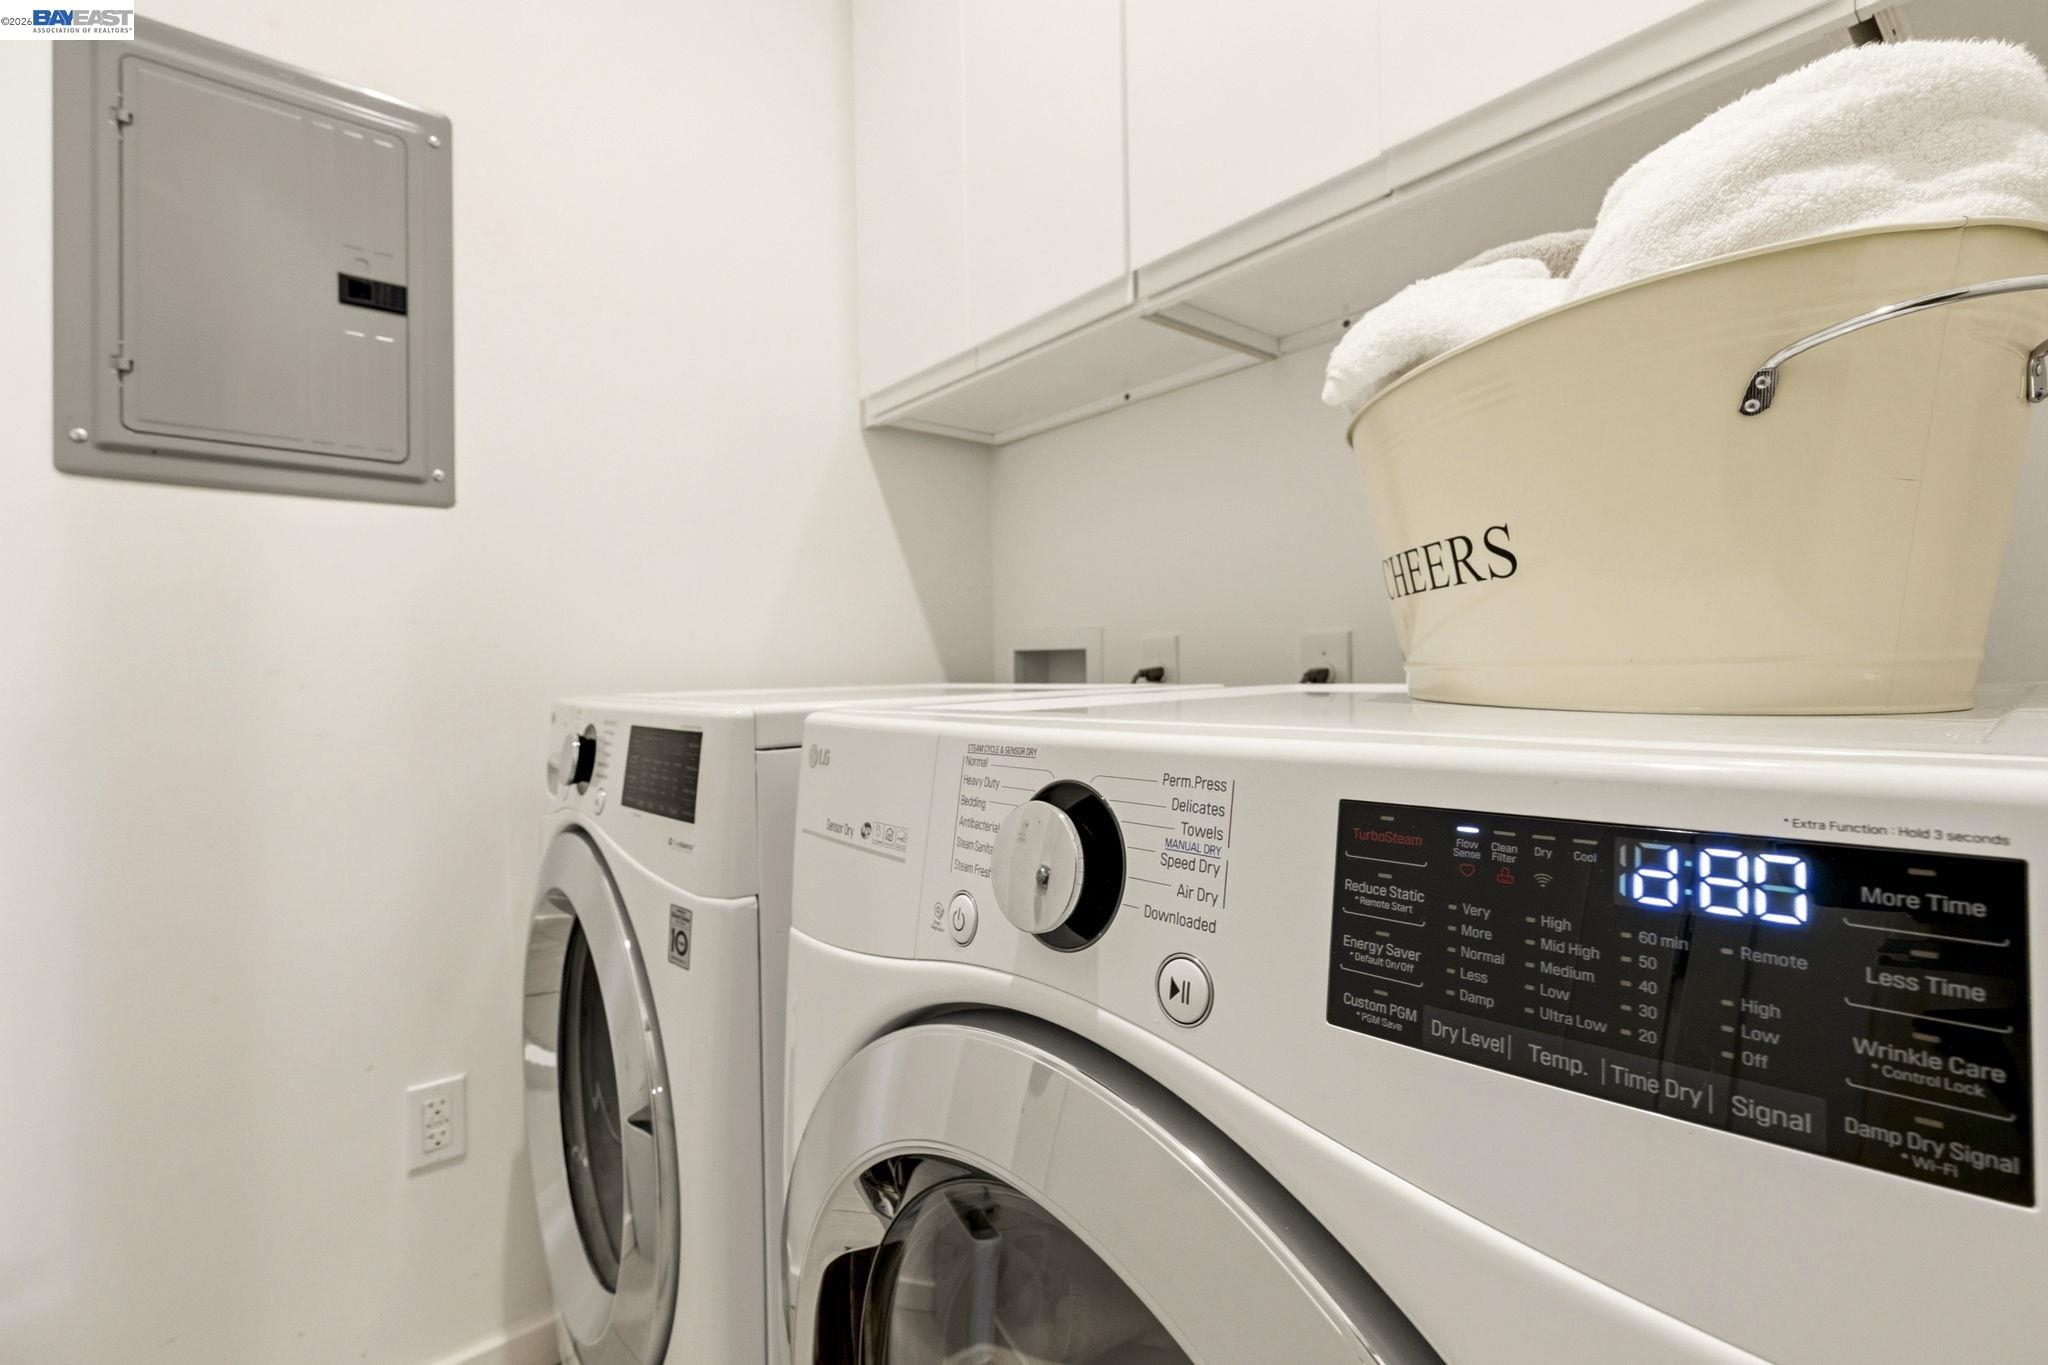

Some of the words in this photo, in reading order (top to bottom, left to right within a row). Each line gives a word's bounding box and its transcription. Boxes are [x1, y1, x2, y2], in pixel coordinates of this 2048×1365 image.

[1382, 523, 1517, 600] CHEERS
[818, 748, 831, 767] LG
[967, 743, 984, 753] STEAM
[984, 745, 1000, 754] CYCLE
[1004, 746, 1026, 755] SENSOR
[1026, 748, 1039, 756] DRY
[965, 756, 988, 767] Normal
[963, 774, 983, 788] Heavy
[984, 777, 1000, 791] Duty
[1162, 773, 1228, 792] Perm.Press
[960, 795, 986, 811] Bedding
[1171, 798, 1226, 818] Delicates
[958, 816, 1000, 834] Antibacterial
[1181, 822, 1224, 841] Towels
[1792, 818, 1826, 831] Extra
[1829, 821, 1888, 836] Function
[1898, 826, 1930, 840] Hold
[1934, 829, 1943, 841] 3
[1947, 830, 2010, 847] seconds
[956, 836, 975, 850] Steam
[975, 840, 994, 855] Sanita
[1352, 827, 1424, 847] TurboSteam
[1456, 838, 1479, 850] Flow
[1164, 837, 1202, 854] MANUAL
[1203, 844, 1222, 857] DRY
[1453, 848, 1481, 860] Sense
[1491, 842, 1518, 854] Clean
[1534, 847, 1553, 859] Dry
[953, 859, 974, 874] Steam
[1160, 853, 1196, 872] Speed
[1199, 859, 1221, 878] Dry
[1491, 852, 1517, 864] Filter
[1573, 851, 1597, 863] Cool
[1176, 884, 1194, 900] Air
[1197, 887, 1219, 907] Dry
[1344, 878, 1387, 897] Reduce
[1389, 885, 1425, 903] Static
[1360, 896, 1390, 910] Remote
[1391, 901, 1414, 914] Start
[1462, 902, 1491, 920] Very
[1860, 886, 1921, 909] More
[1924, 893, 1987, 918] Time
[1144, 904, 1217, 934] Downloaded
[1540, 915, 1572, 932] High
[1461, 924, 1493, 940] More
[1638, 932, 1658, 946] 60
[1660, 936, 1689, 951] min
[1343, 934, 1384, 955] Energy
[1385, 943, 1421, 961] Saver
[1460, 946, 1505, 965] Normal
[1540, 938, 1566, 955] Mid
[1568, 942, 1601, 961] High
[1354, 952, 1384, 967] Default
[1385, 959, 1415, 973] On/Off
[1638, 956, 1658, 970] 50
[1740, 946, 1809, 970] Remote
[1460, 967, 1488, 984] Less
[1540, 961, 1596, 983] Medium
[1540, 983, 1571, 1001] Low
[1638, 980, 1658, 995] 40
[1865, 966, 1920, 991] Less
[1924, 976, 1987, 1002] Time
[1343, 992, 1387, 1013] Custom
[1389, 1004, 1418, 1022] PGM
[1459, 989, 1495, 1009] Damp
[1638, 1004, 1658, 1019] 30
[1740, 999, 1782, 1019] High
[1361, 1012, 1380, 1025] PGM
[1381, 1018, 1403, 1031] Save
[1539, 1007, 1573, 1025] Ultra
[1576, 1014, 1608, 1033] Low
[1431, 1019, 1460, 1045] Dry
[1462, 1027, 1505, 1054] Level
[1638, 1029, 1658, 1044] 20
[1740, 1024, 1780, 1045] Low
[1528, 1043, 1589, 1076] Temp.
[1741, 1051, 1769, 1070] Off
[1852, 1036, 1943, 1070] Wrinkle
[1948, 1056, 2007, 1084] Care
[1610, 1064, 1659, 1093] Time
[1665, 1078, 1703, 1109] Dry
[1881, 1064, 1942, 1088] Control
[1943, 1078, 1987, 1098] Lock
[1731, 1095, 1812, 1133] Signal
[1843, 1116, 1902, 1148] Damp
[1907, 1131, 1946, 1159] Dry
[1950, 1141, 2021, 1175] Signal
